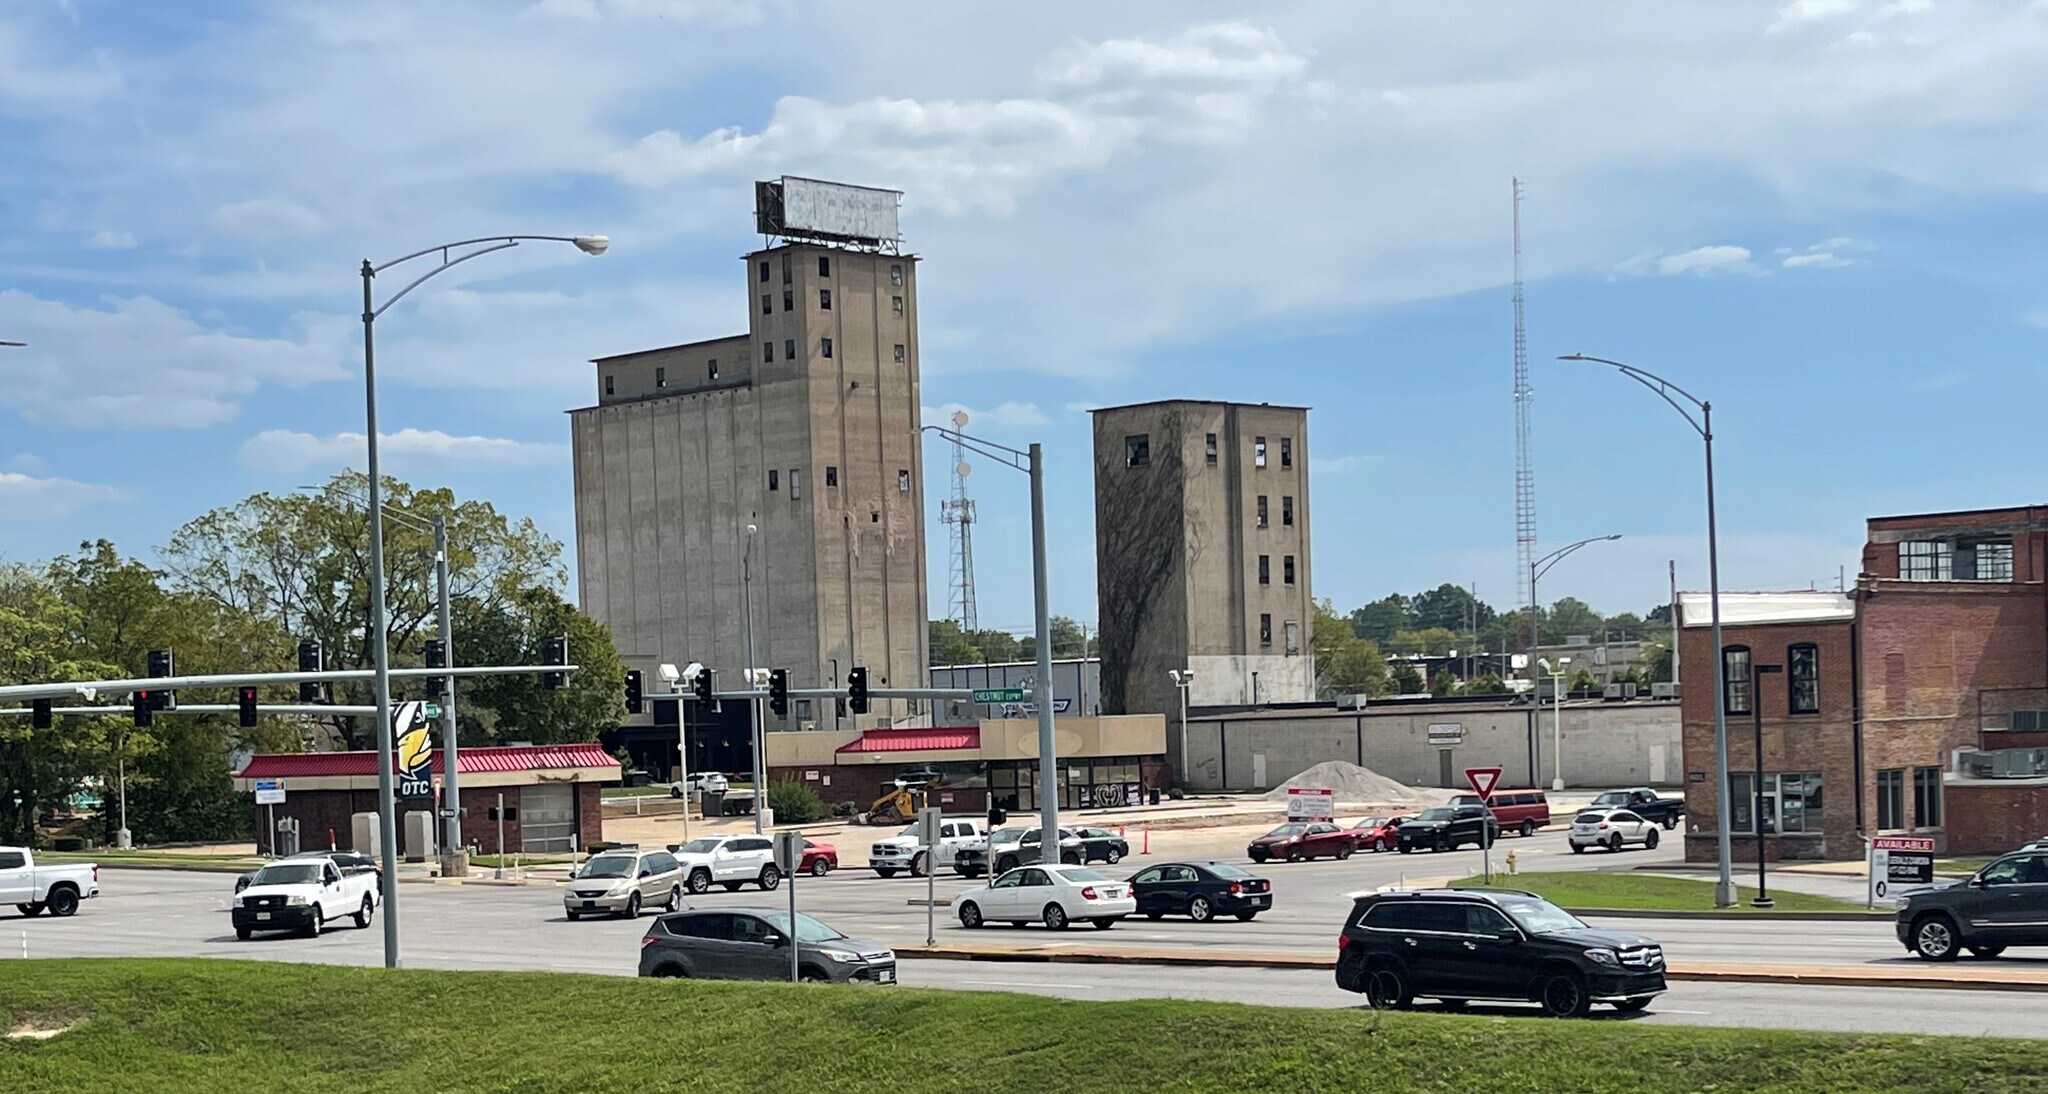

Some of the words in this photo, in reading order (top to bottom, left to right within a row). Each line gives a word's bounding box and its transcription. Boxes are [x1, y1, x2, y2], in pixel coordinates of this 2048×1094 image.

[975, 691, 1004, 701] CHESTNUT
[402, 781, 429, 795] OTC
[1876, 840, 1930, 850] AVAILABLE
